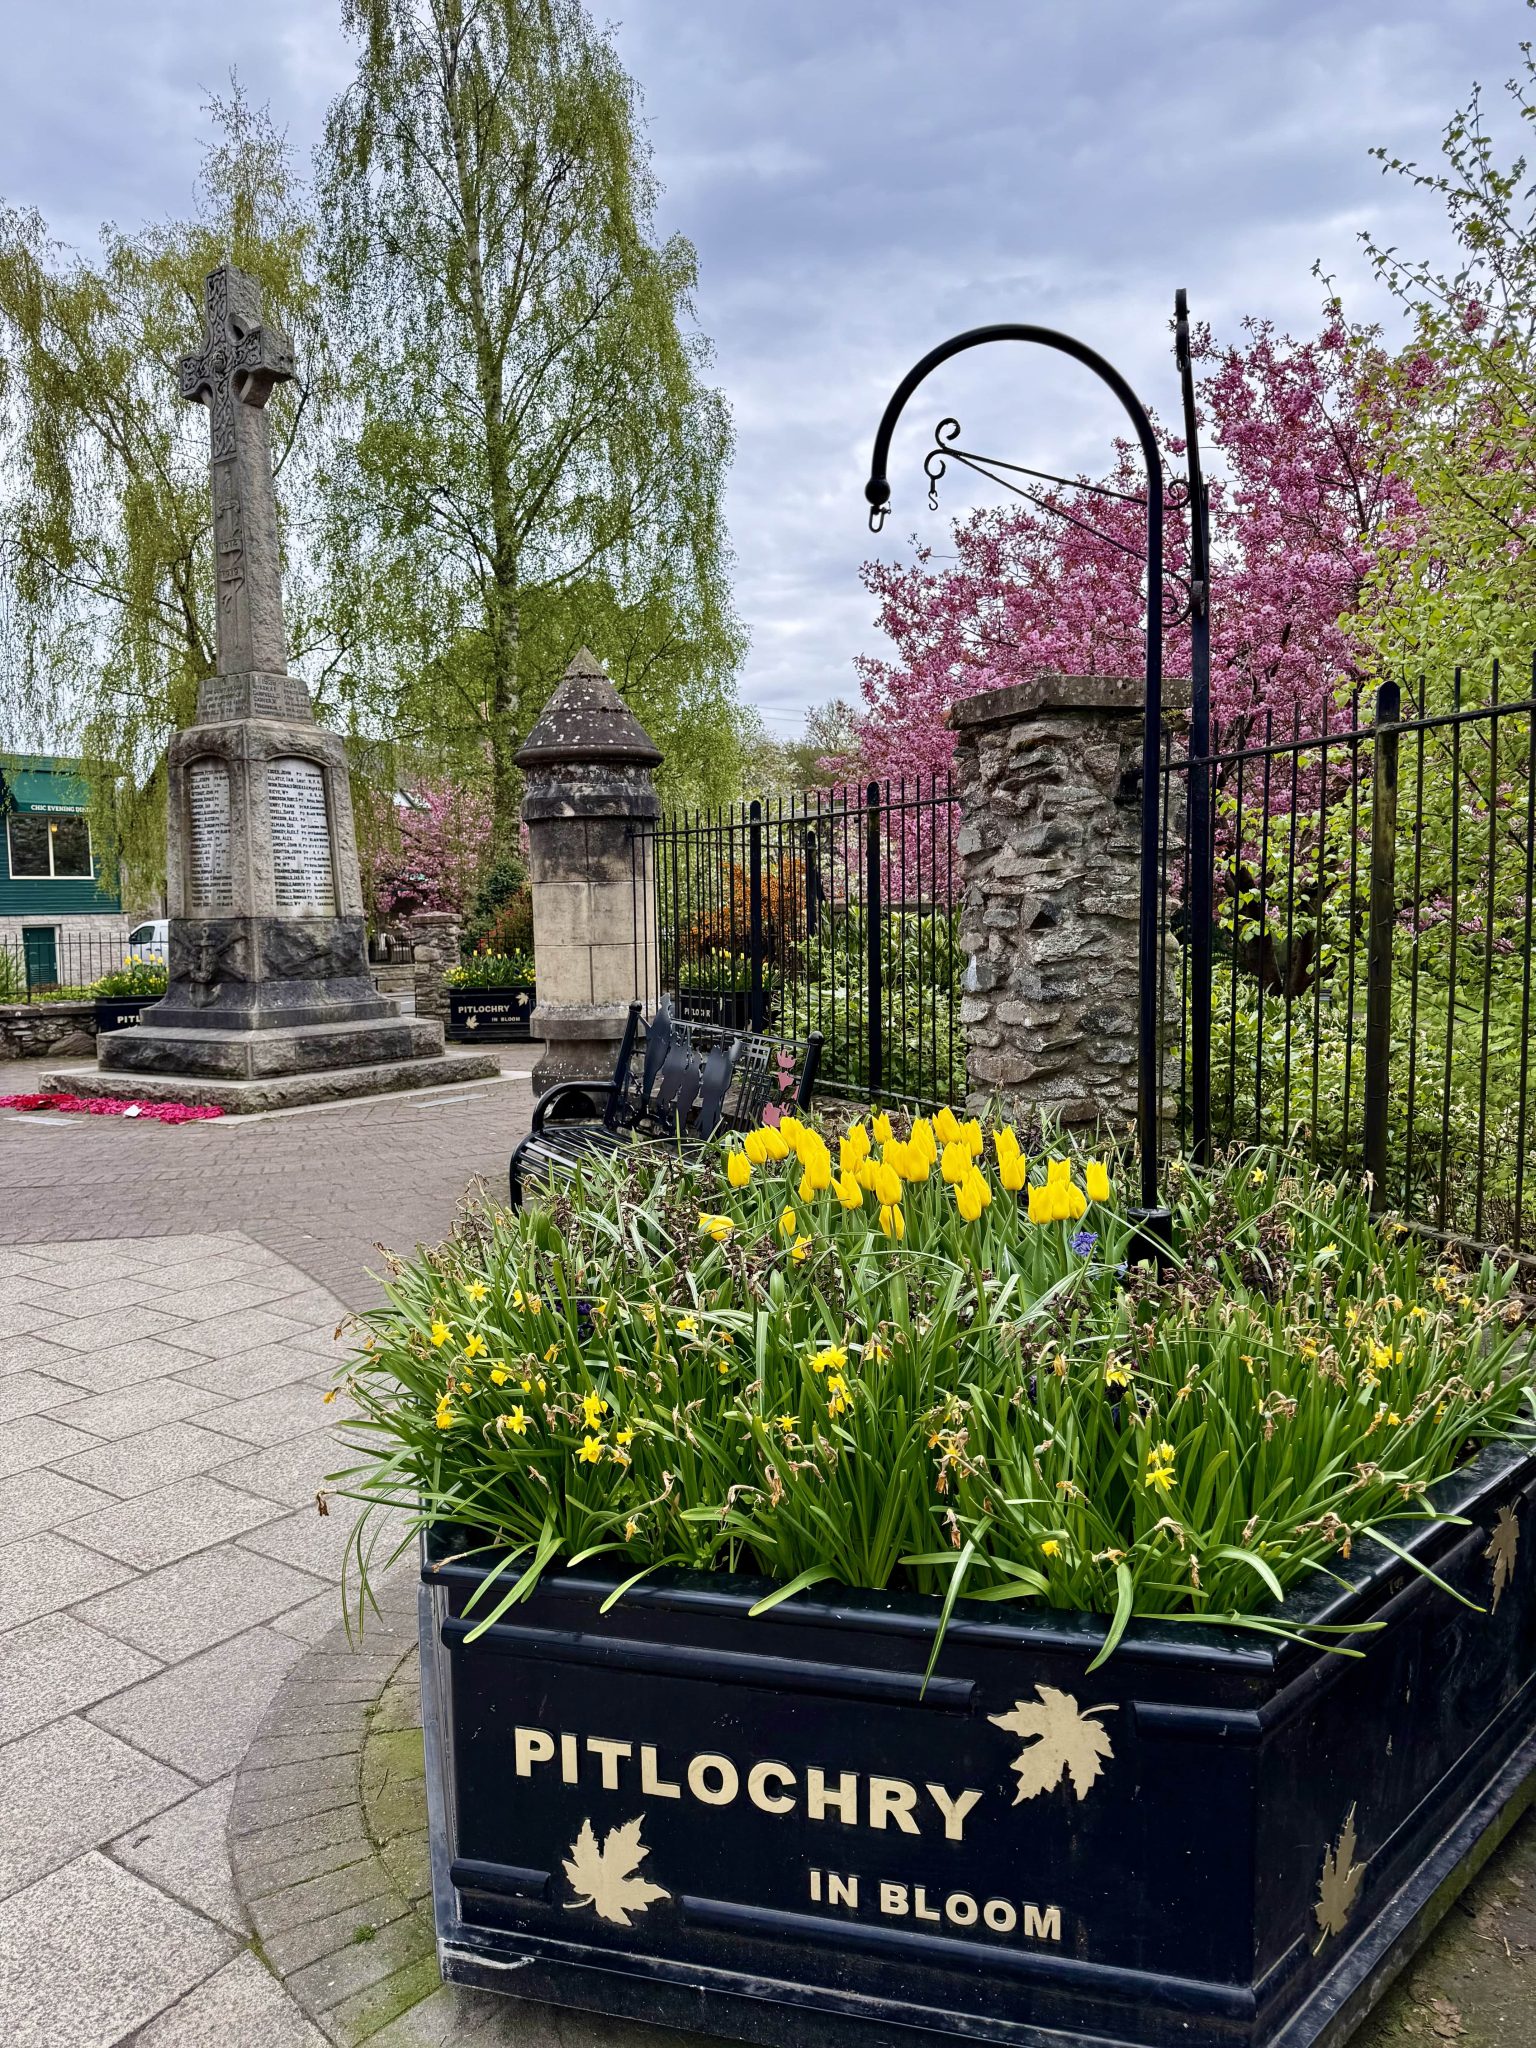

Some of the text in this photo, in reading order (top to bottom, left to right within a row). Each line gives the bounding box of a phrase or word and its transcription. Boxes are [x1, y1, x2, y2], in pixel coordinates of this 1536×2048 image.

[458, 1005, 510, 1014] PITLOCHRY
[514, 1726, 984, 1842] PITLOCHRY
[809, 1869, 1063, 1942] IN BLOOM
